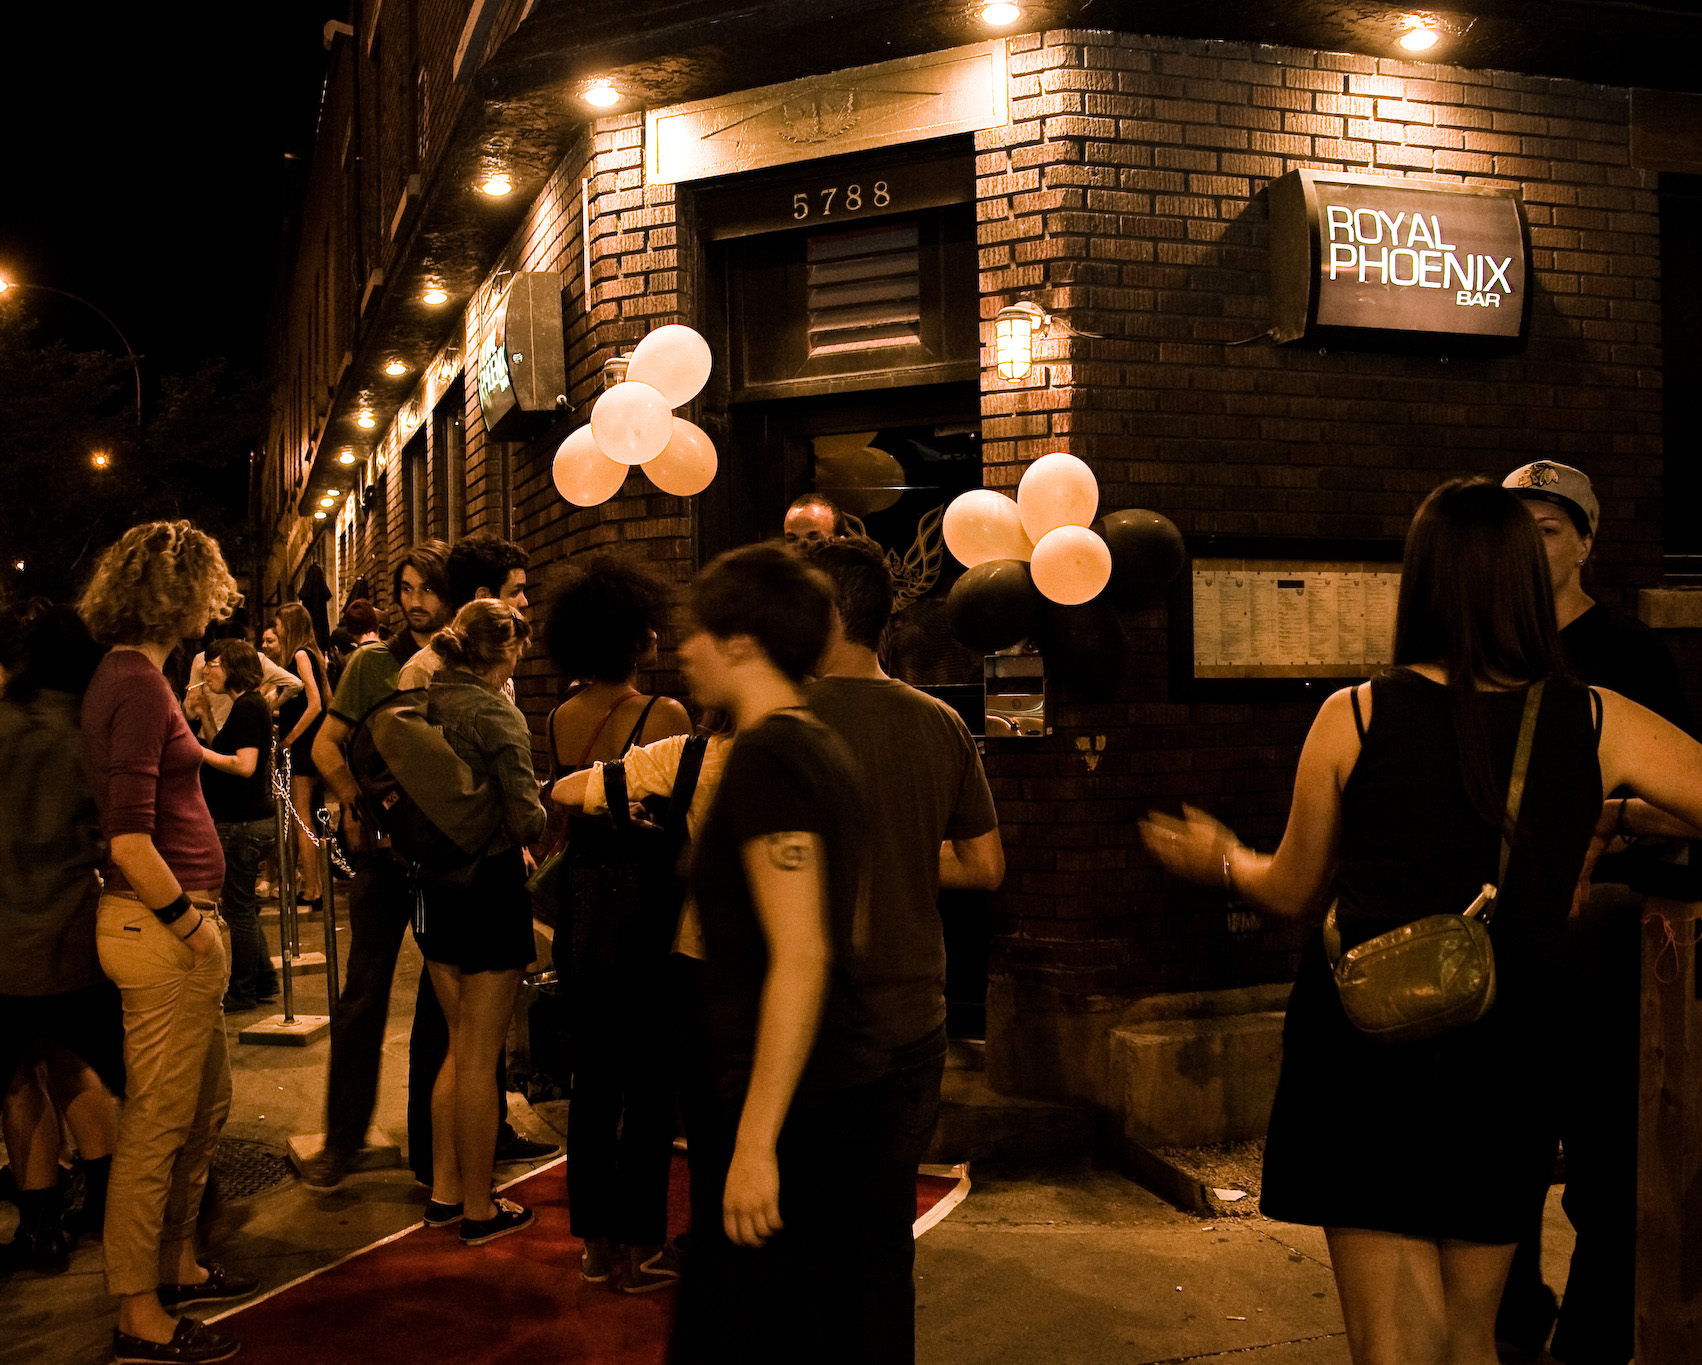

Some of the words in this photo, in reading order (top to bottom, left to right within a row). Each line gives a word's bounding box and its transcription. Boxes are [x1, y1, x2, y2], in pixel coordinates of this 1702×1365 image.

[793, 181, 890, 220] 5788
[1327, 206, 1456, 251] ROYAL
[1330, 243, 1512, 294] PHOENIX
[1456, 291, 1501, 308] BAR
